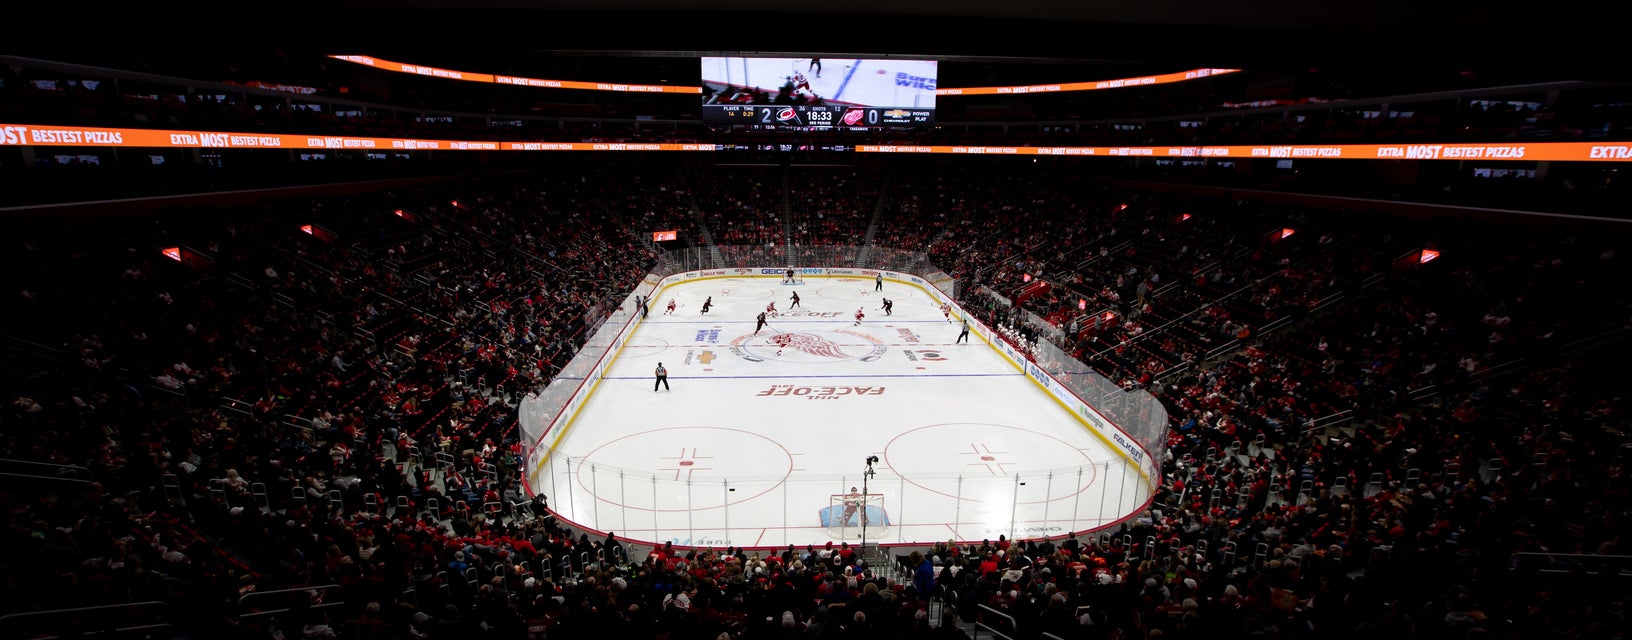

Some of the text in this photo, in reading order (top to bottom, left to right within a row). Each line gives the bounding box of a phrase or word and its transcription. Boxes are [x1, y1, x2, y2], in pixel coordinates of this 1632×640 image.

[762, 108, 771, 123] 2
[807, 111, 832, 120] 18:33
[868, 110, 877, 124] 0
[31, 129, 83, 143] BESTEST
[84, 131, 123, 144] PIZZAS
[170, 132, 281, 147] EXTRA MOST BESTEST PIZZAS
[325, 137, 343, 148] MOST
[1252, 146, 1341, 157] EXTRA MOST BESTEST PIZZAS
[1377, 146, 1525, 159] EXTRA MOST BESTEST PIZZAS
[755, 387, 886, 396] FACE-OFF
